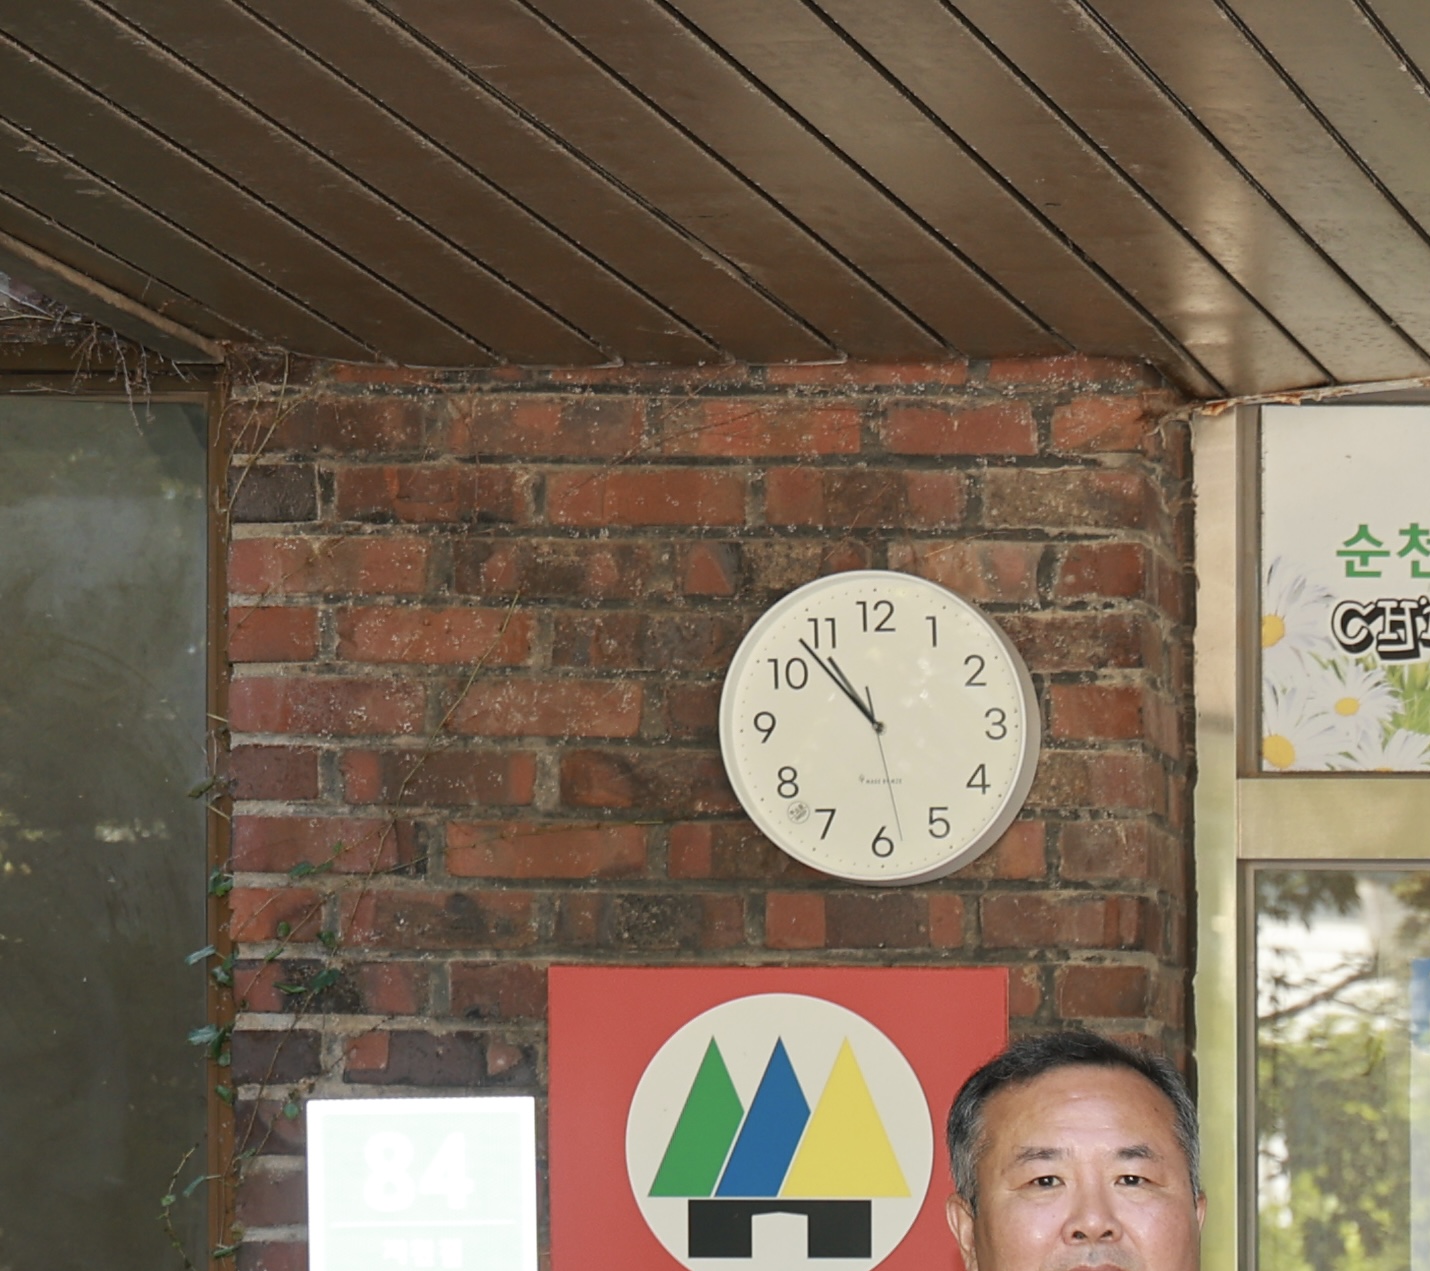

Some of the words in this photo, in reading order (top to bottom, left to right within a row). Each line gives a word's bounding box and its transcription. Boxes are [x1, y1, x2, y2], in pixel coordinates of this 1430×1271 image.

[856, 600, 896, 632] 12
[925, 616, 938, 647] 1
[807, 618, 837, 649] 11
[767, 657, 808, 690] 10
[964, 655, 987, 686] 2
[753, 711, 776, 743] 9
[984, 708, 1007, 739] 3
[777, 766, 799, 798] 8
[966, 764, 990, 794] 4
[815, 808, 836, 840] 7
[928, 807, 950, 838] 5
[872, 826, 894, 857] 6
[363, 1131, 474, 1212] 84
